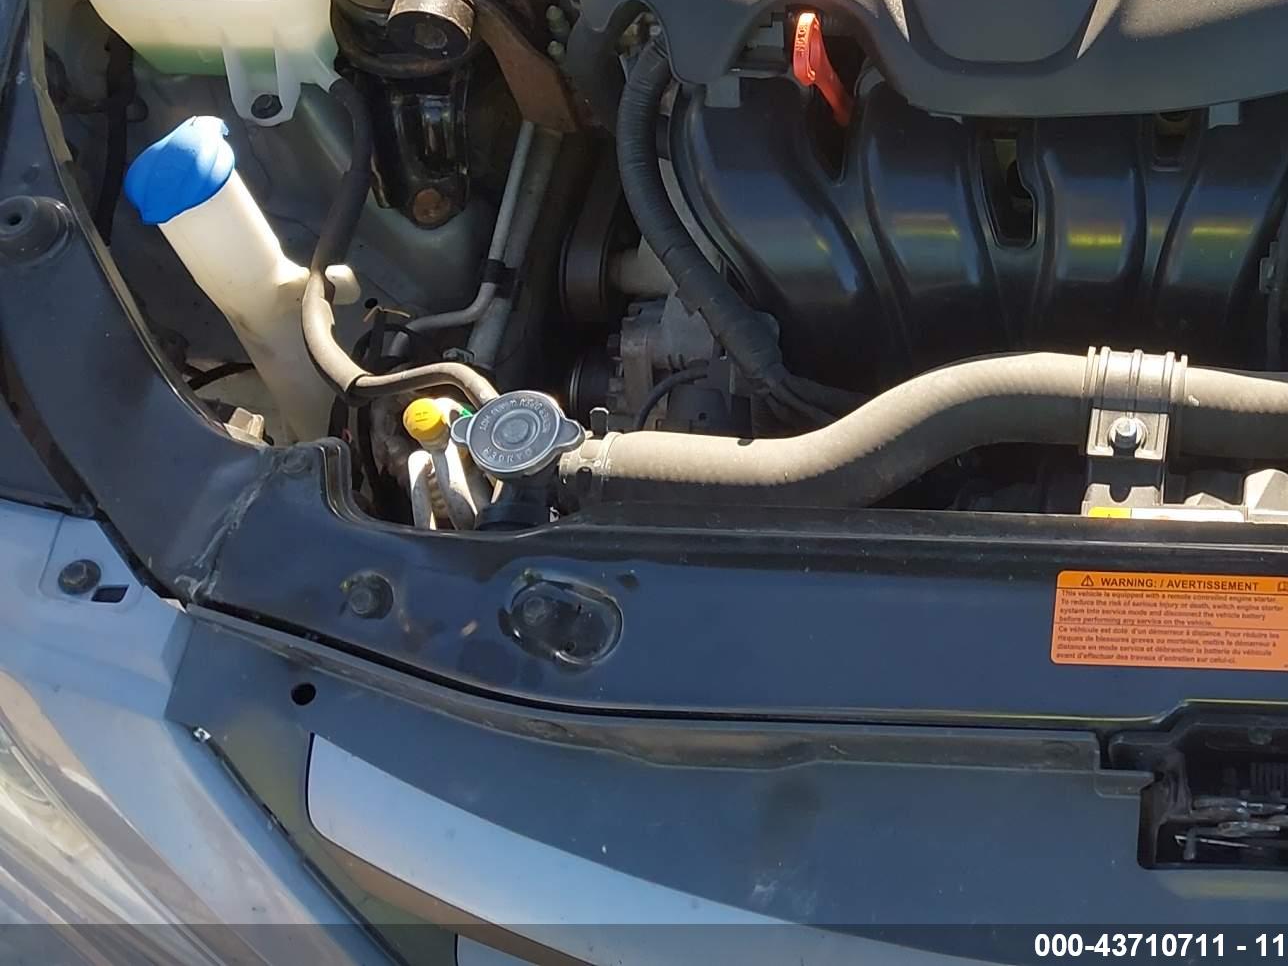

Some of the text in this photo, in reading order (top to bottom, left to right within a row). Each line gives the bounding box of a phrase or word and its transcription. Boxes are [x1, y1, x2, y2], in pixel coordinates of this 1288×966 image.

[483, 446, 533, 463] DANGER
[1166, 579, 1258, 590] AVERTISSEMENT
[1111, 591, 1143, 599] equipped
[1228, 594, 1251, 602] engine
